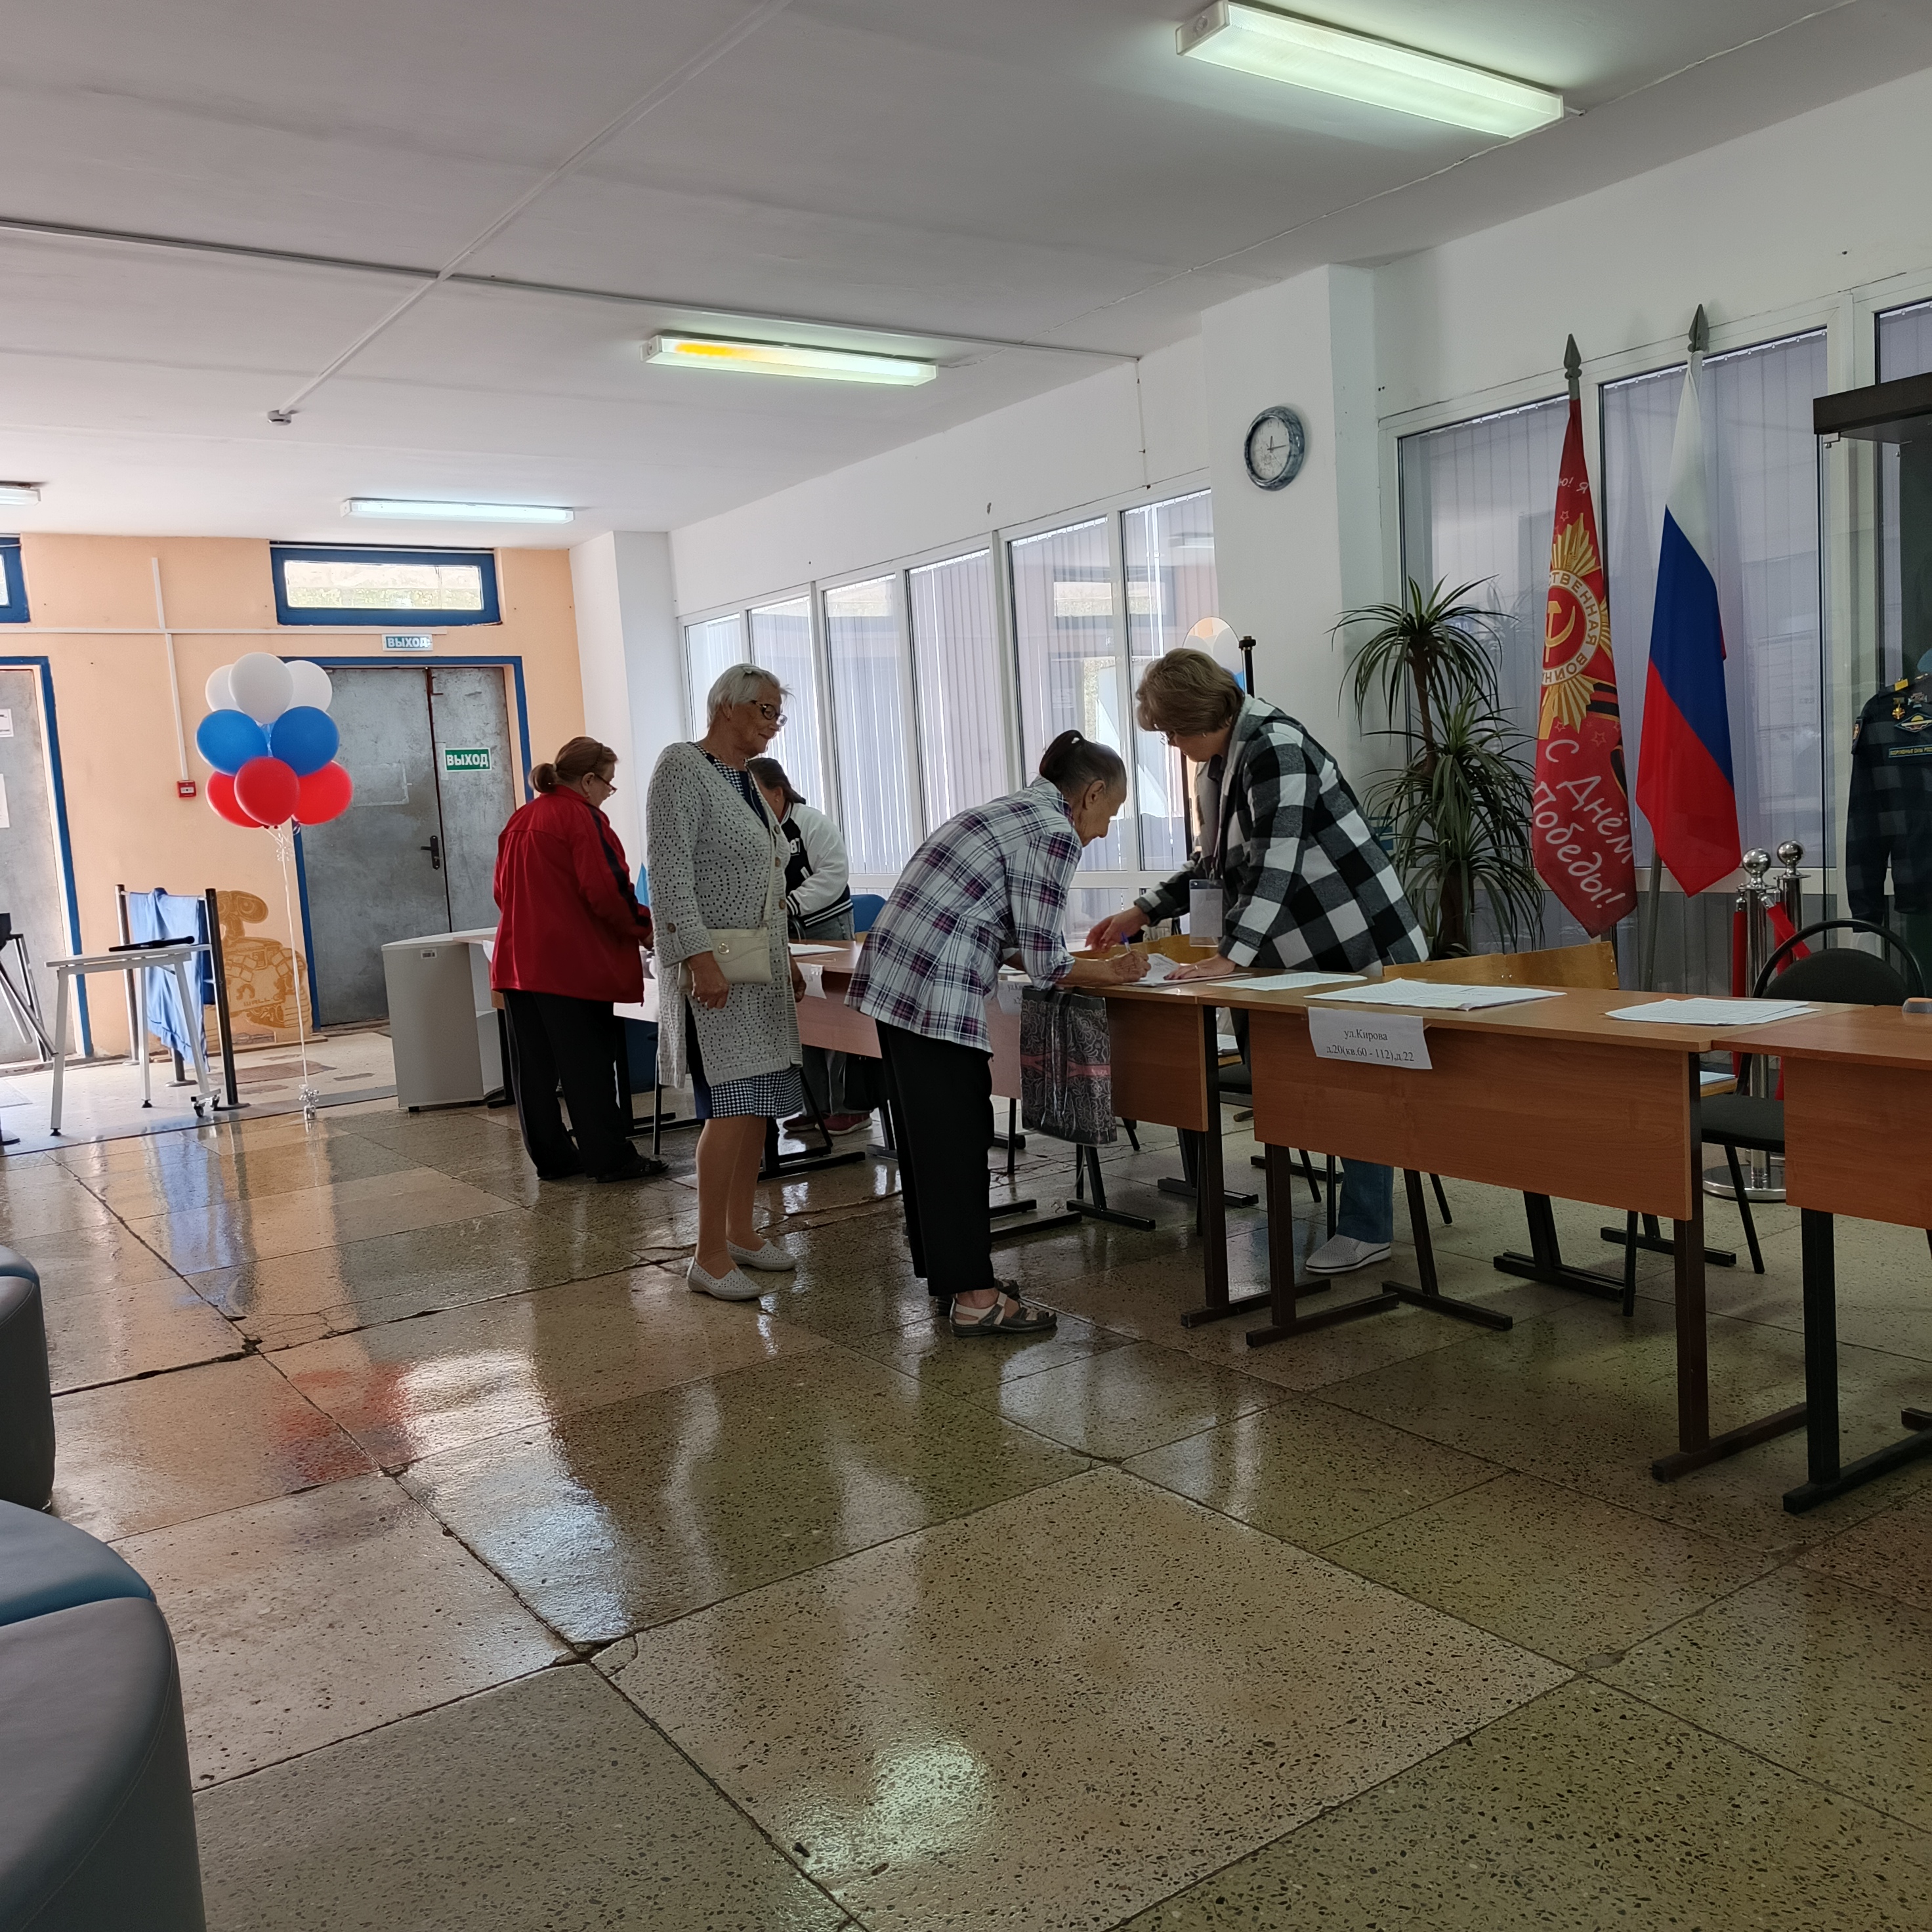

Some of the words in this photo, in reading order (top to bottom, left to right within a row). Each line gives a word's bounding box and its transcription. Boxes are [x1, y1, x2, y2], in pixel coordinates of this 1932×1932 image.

[387, 637, 427, 648] ВЫХОД
[446, 754, 489, 767] ВЫХОД
[1556, 776, 1633, 864] Днём
[1344, 1028, 1388, 1041] ул.Кирова
